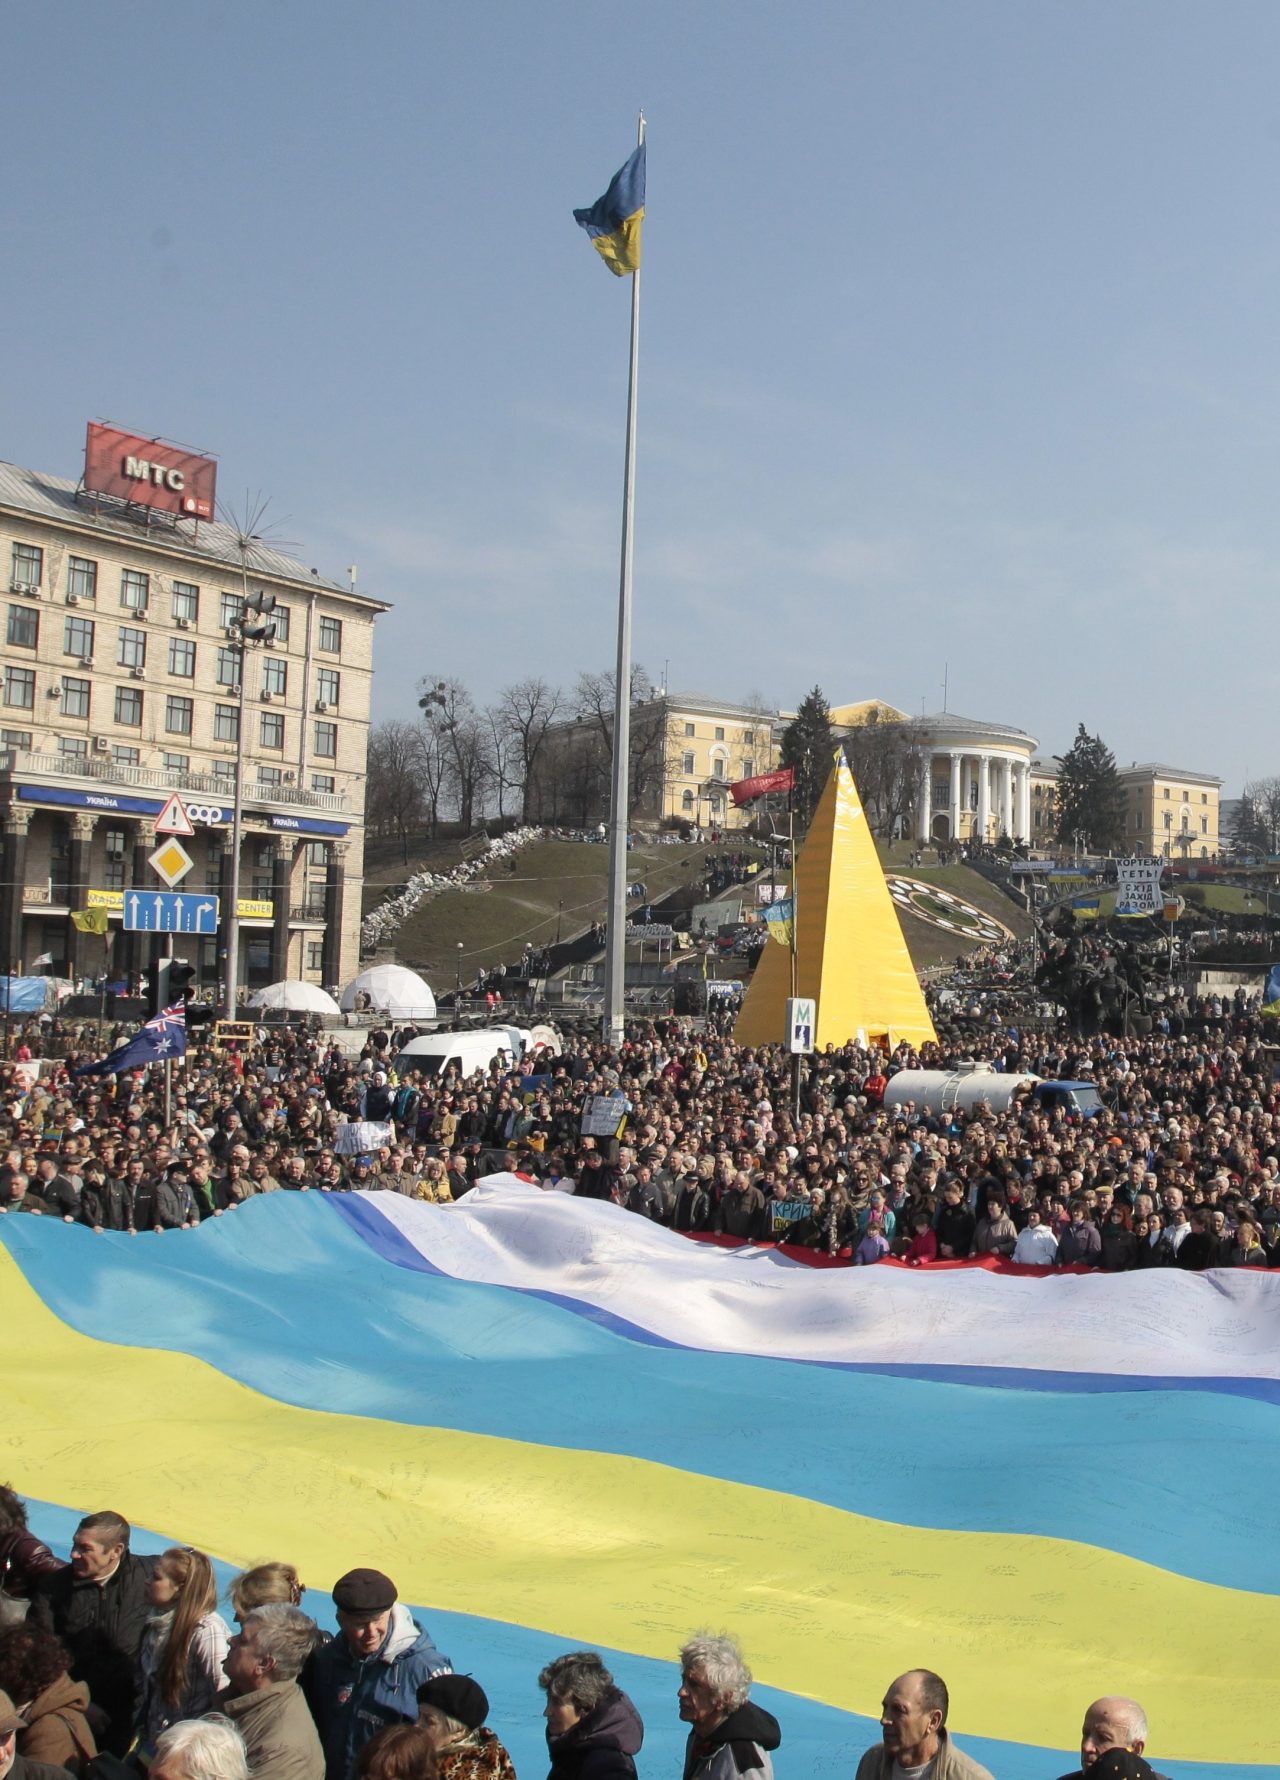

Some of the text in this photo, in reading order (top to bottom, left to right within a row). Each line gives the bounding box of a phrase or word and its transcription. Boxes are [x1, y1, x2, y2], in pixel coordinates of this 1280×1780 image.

[124, 456, 185, 490] МТС
[86, 796, 118, 808] УКРАЇНА
[272, 818, 299, 829] УКРАЇНА
[1125, 883, 1153, 893] СХІД
[1125, 892, 1153, 901] ЗАХІД
[88, 893, 272, 914] MAIDA CENTER
[1119, 901, 1159, 910] РАЗОМ!
[774, 1200, 813, 1219] КРИМ
